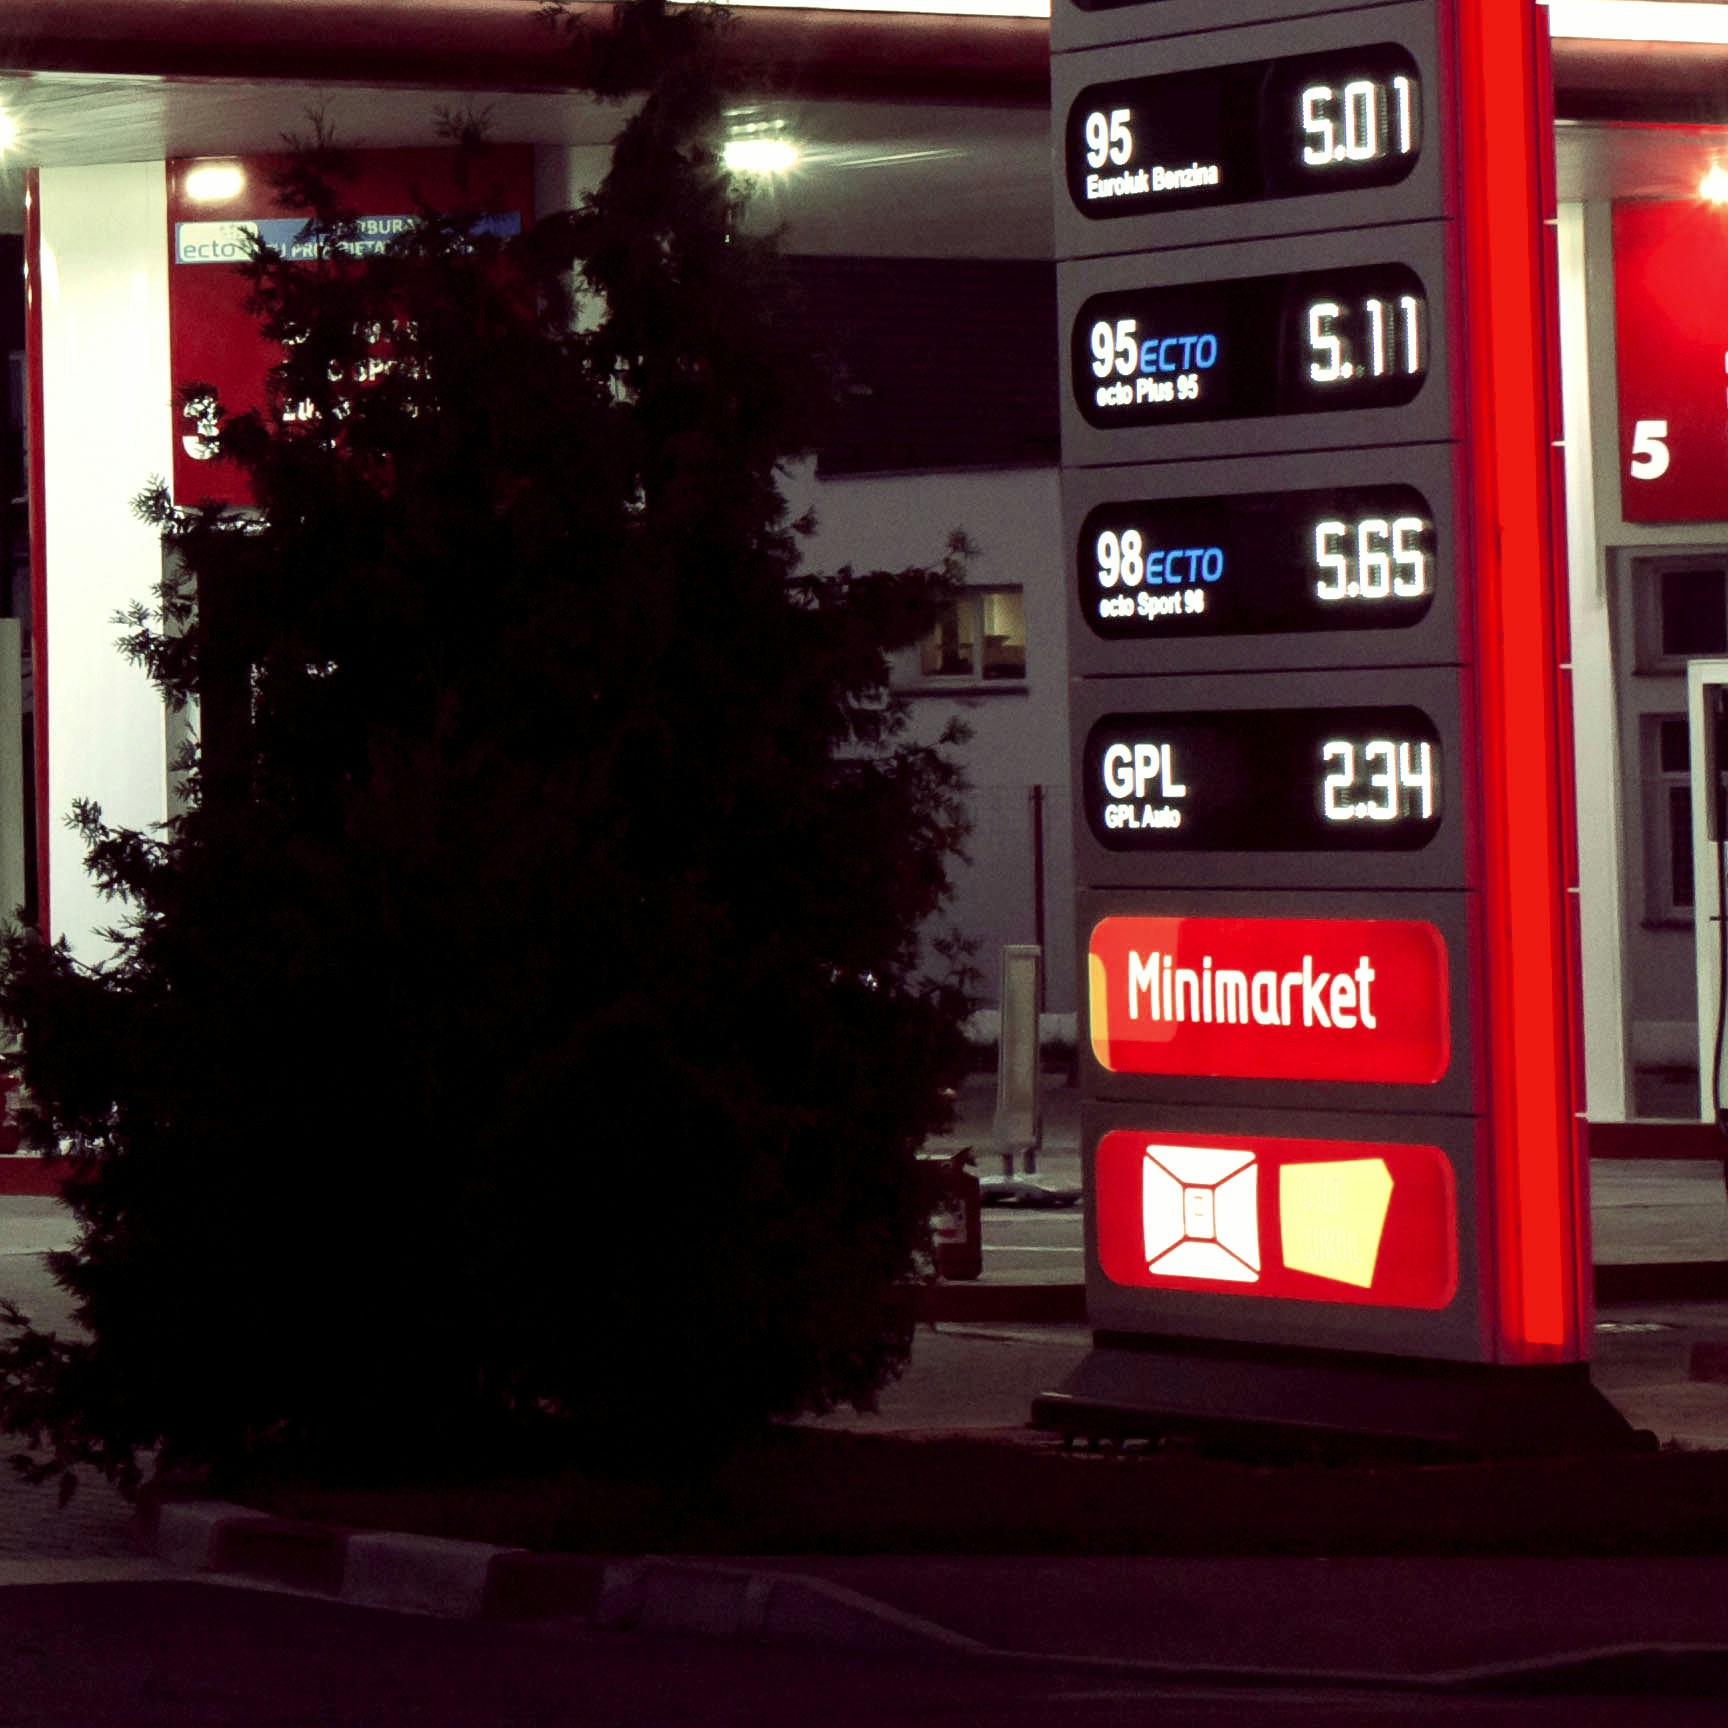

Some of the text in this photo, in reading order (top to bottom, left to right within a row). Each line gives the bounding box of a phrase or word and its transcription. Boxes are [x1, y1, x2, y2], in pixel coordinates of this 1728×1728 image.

[1085, 108, 1133, 169] 95
[1302, 75, 1411, 166] 5.01
[1086, 162, 1220, 201] Euroluk Benzina
[1091, 319, 1218, 378] 95 ECTO
[1309, 296, 1418, 382] 5.11
[1096, 374, 1200, 408] ecto Plus 95
[1630, 419, 1671, 481] 5
[1096, 529, 1225, 588] 98 ECTO
[1315, 517, 1424, 601] 5.65
[1100, 594, 1134, 618] ecto
[1137, 589, 1182, 621] Sport
[1103, 743, 1187, 799] GPL
[1323, 740, 1431, 821] 2.34
[1104, 804, 1181, 830] GPL Auto
[1128, 949, 1377, 1029] Minimarket
